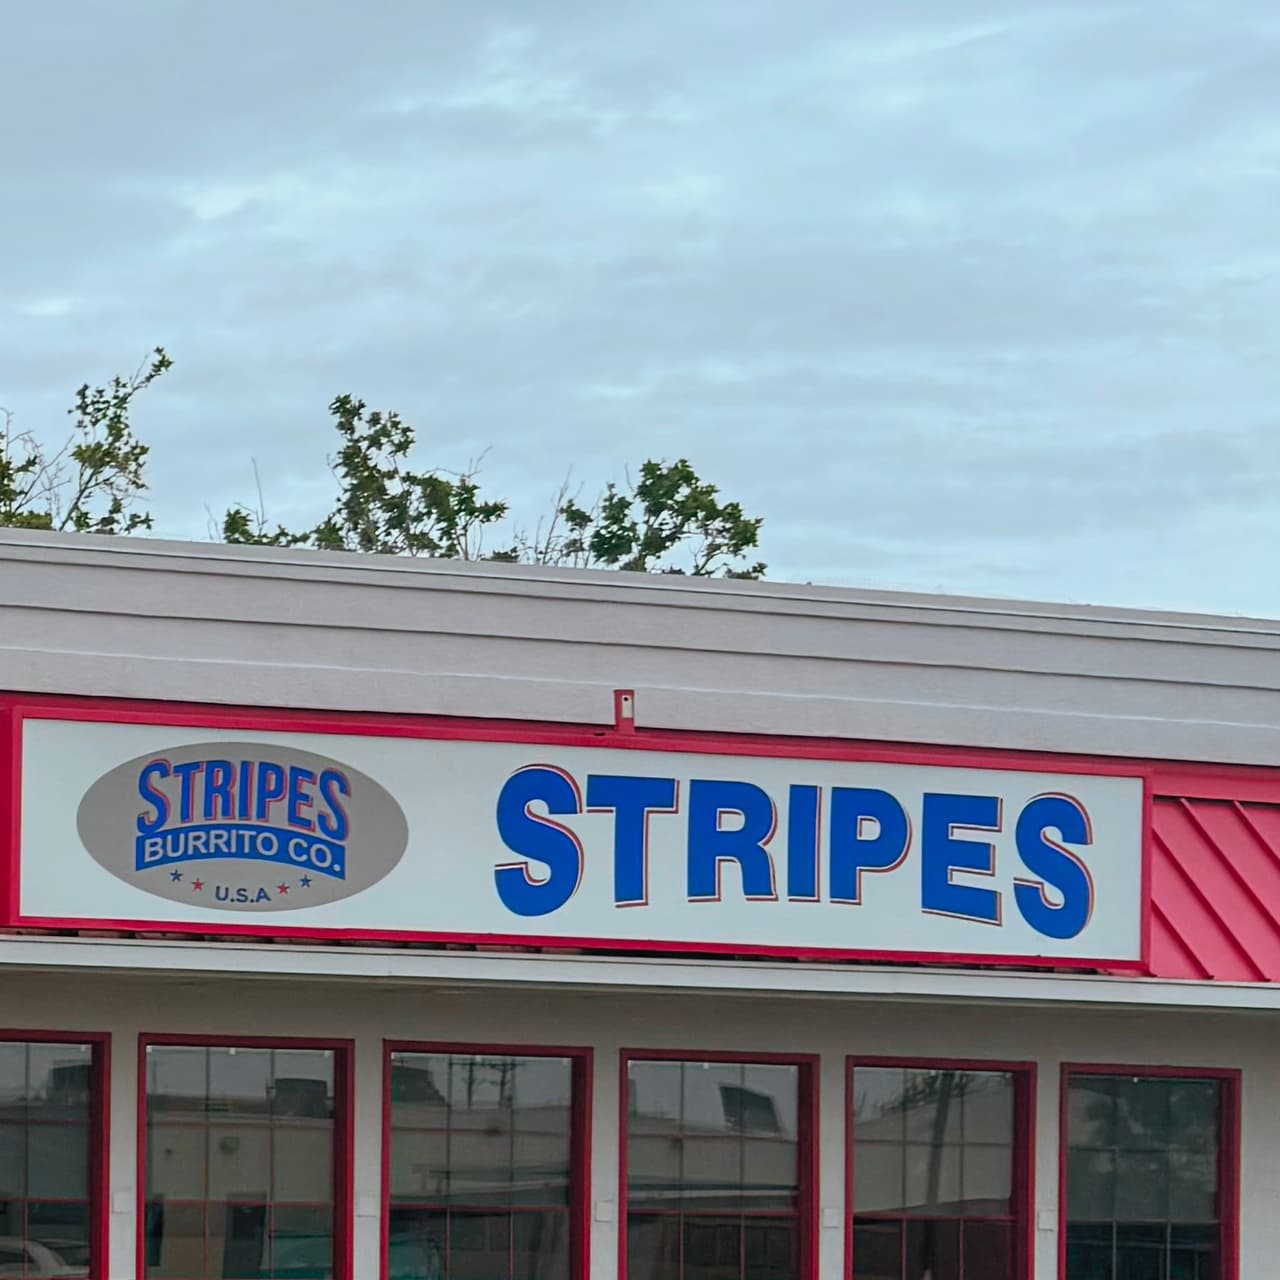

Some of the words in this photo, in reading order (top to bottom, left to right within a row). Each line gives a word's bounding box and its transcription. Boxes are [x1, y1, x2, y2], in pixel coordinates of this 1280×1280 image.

[136, 757, 353, 845] STRIPES
[143, 829, 280, 863] BURRITO
[287, 837, 342, 872] CO.
[493, 763, 1097, 940] STRIPES
[214, 885, 272, 904] U.S.A
